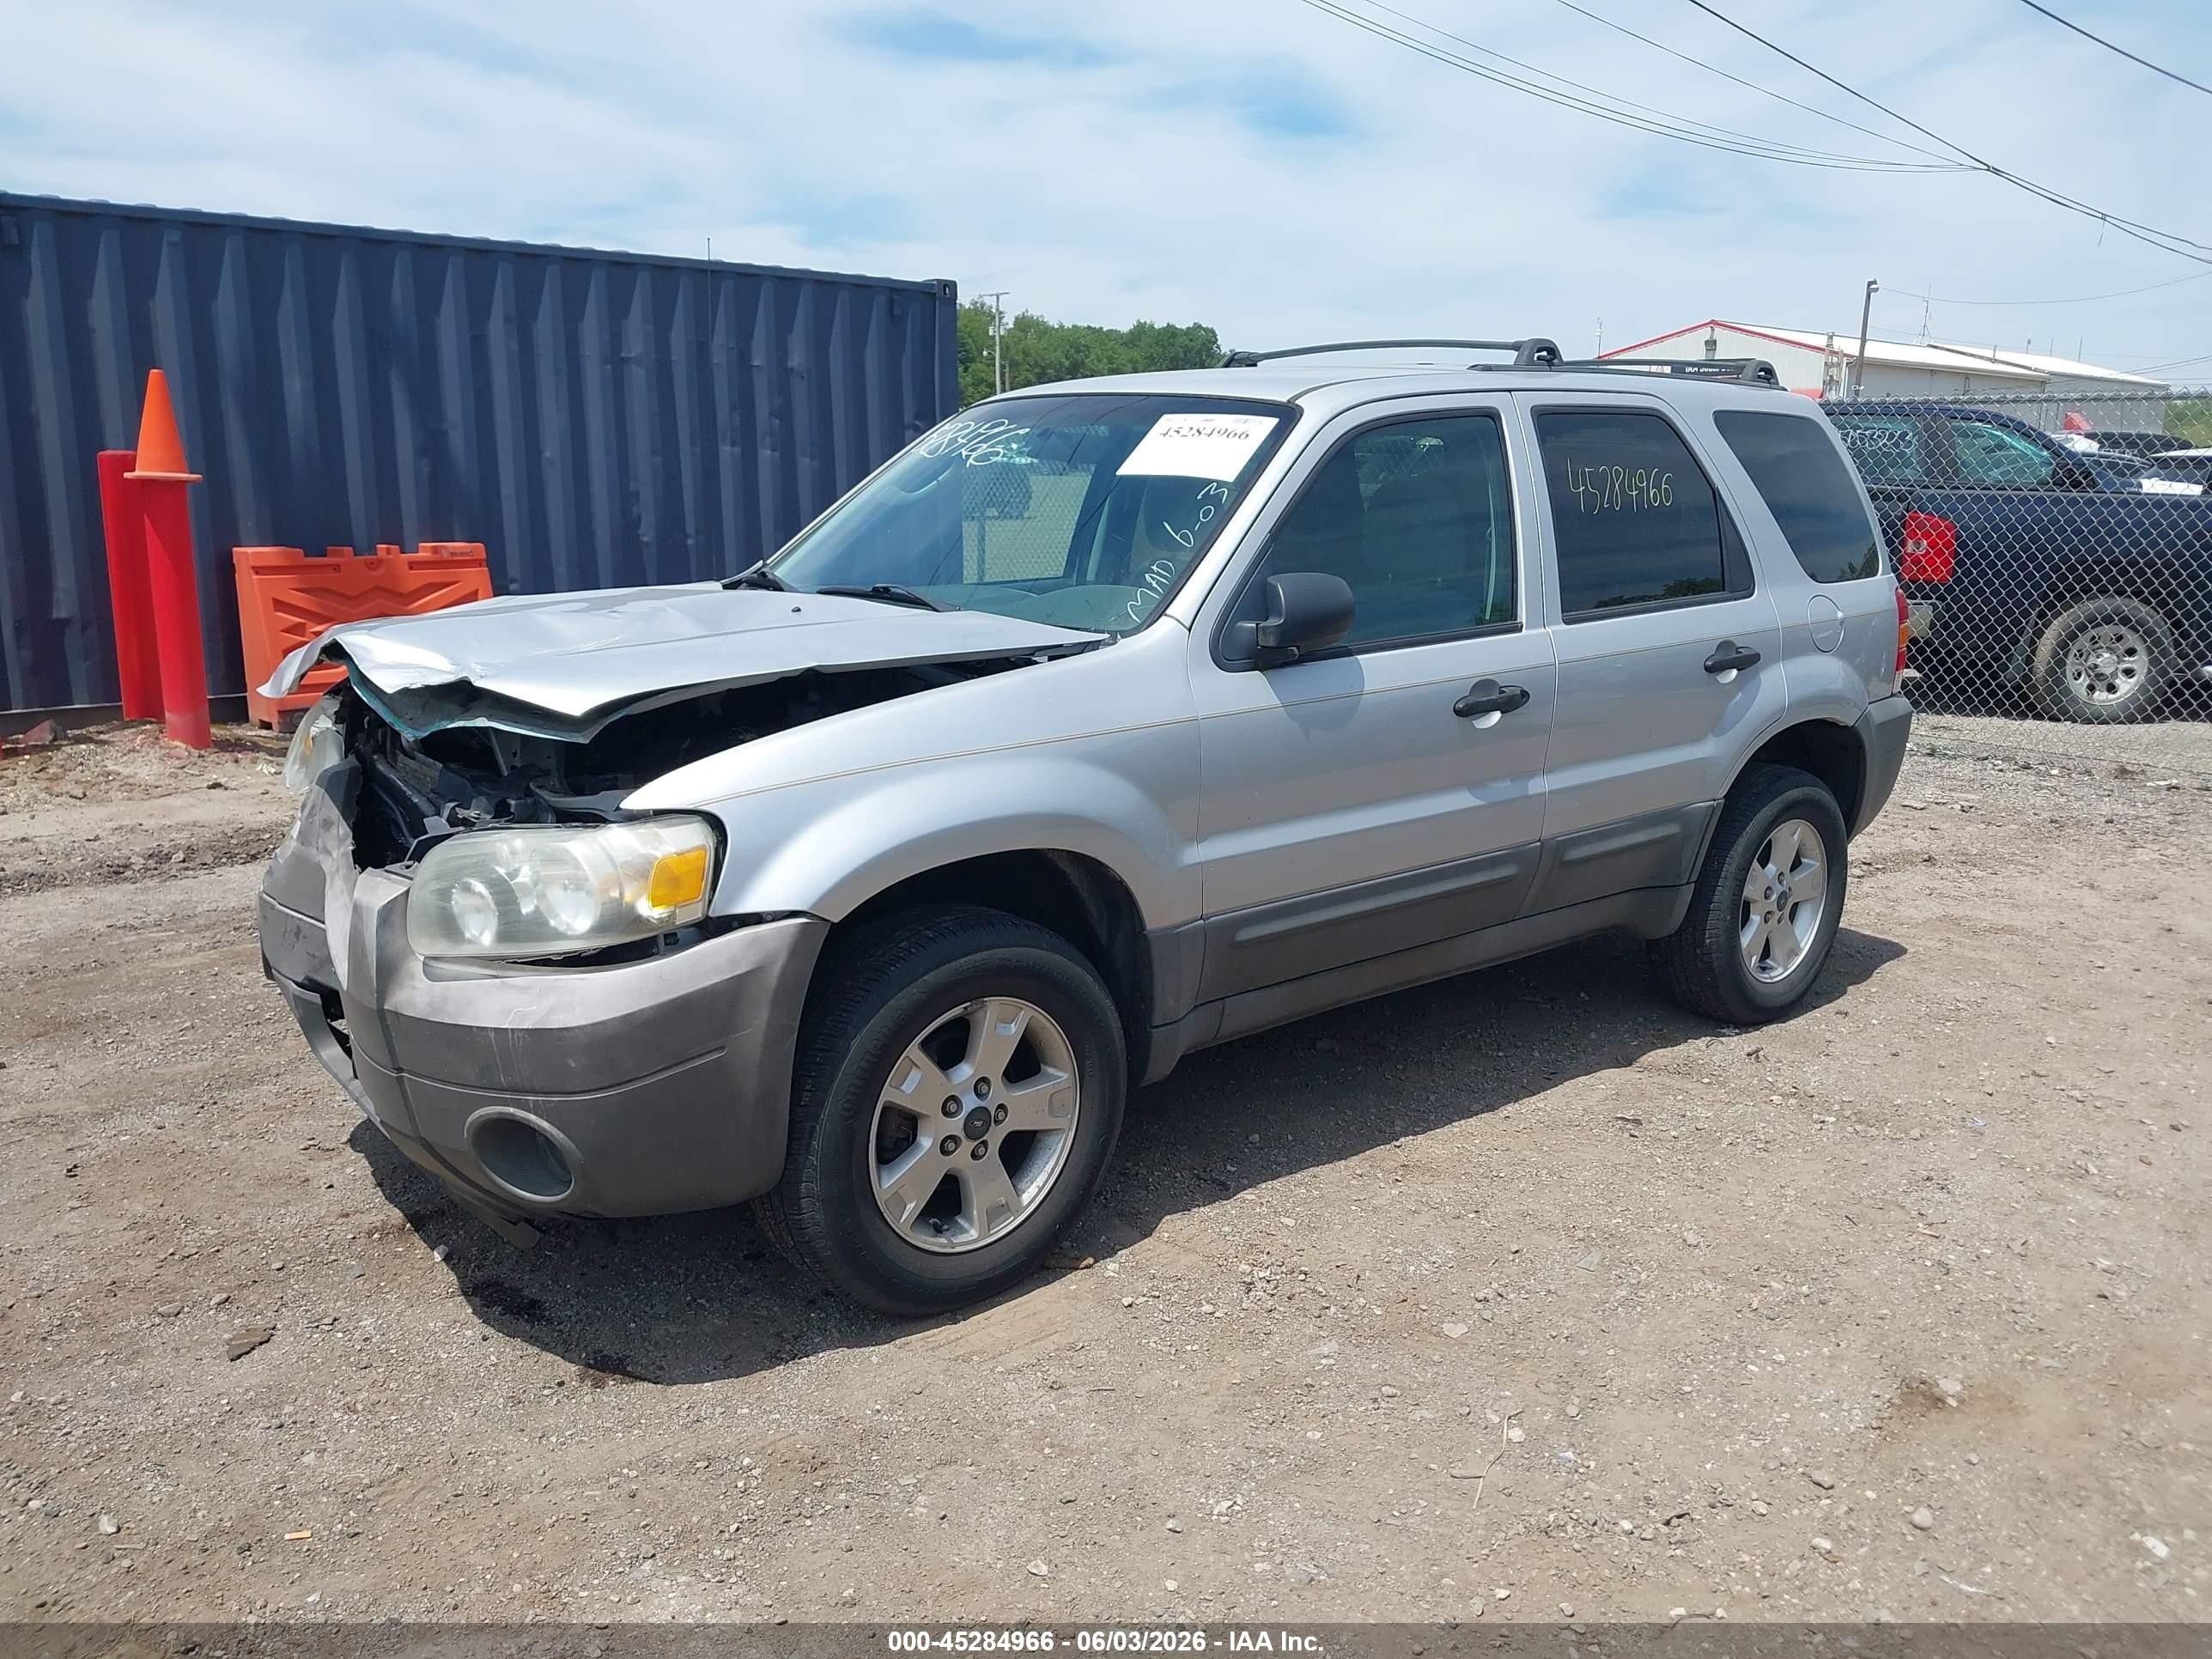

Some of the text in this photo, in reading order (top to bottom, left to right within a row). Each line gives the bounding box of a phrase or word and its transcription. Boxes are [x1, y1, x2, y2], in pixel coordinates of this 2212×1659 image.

[1159, 427, 1250, 441] 45284966
[1566, 457, 1674, 515] 45284966
[1127, 560, 1176, 624] MAD
[1163, 482, 1229, 548] 6-03
